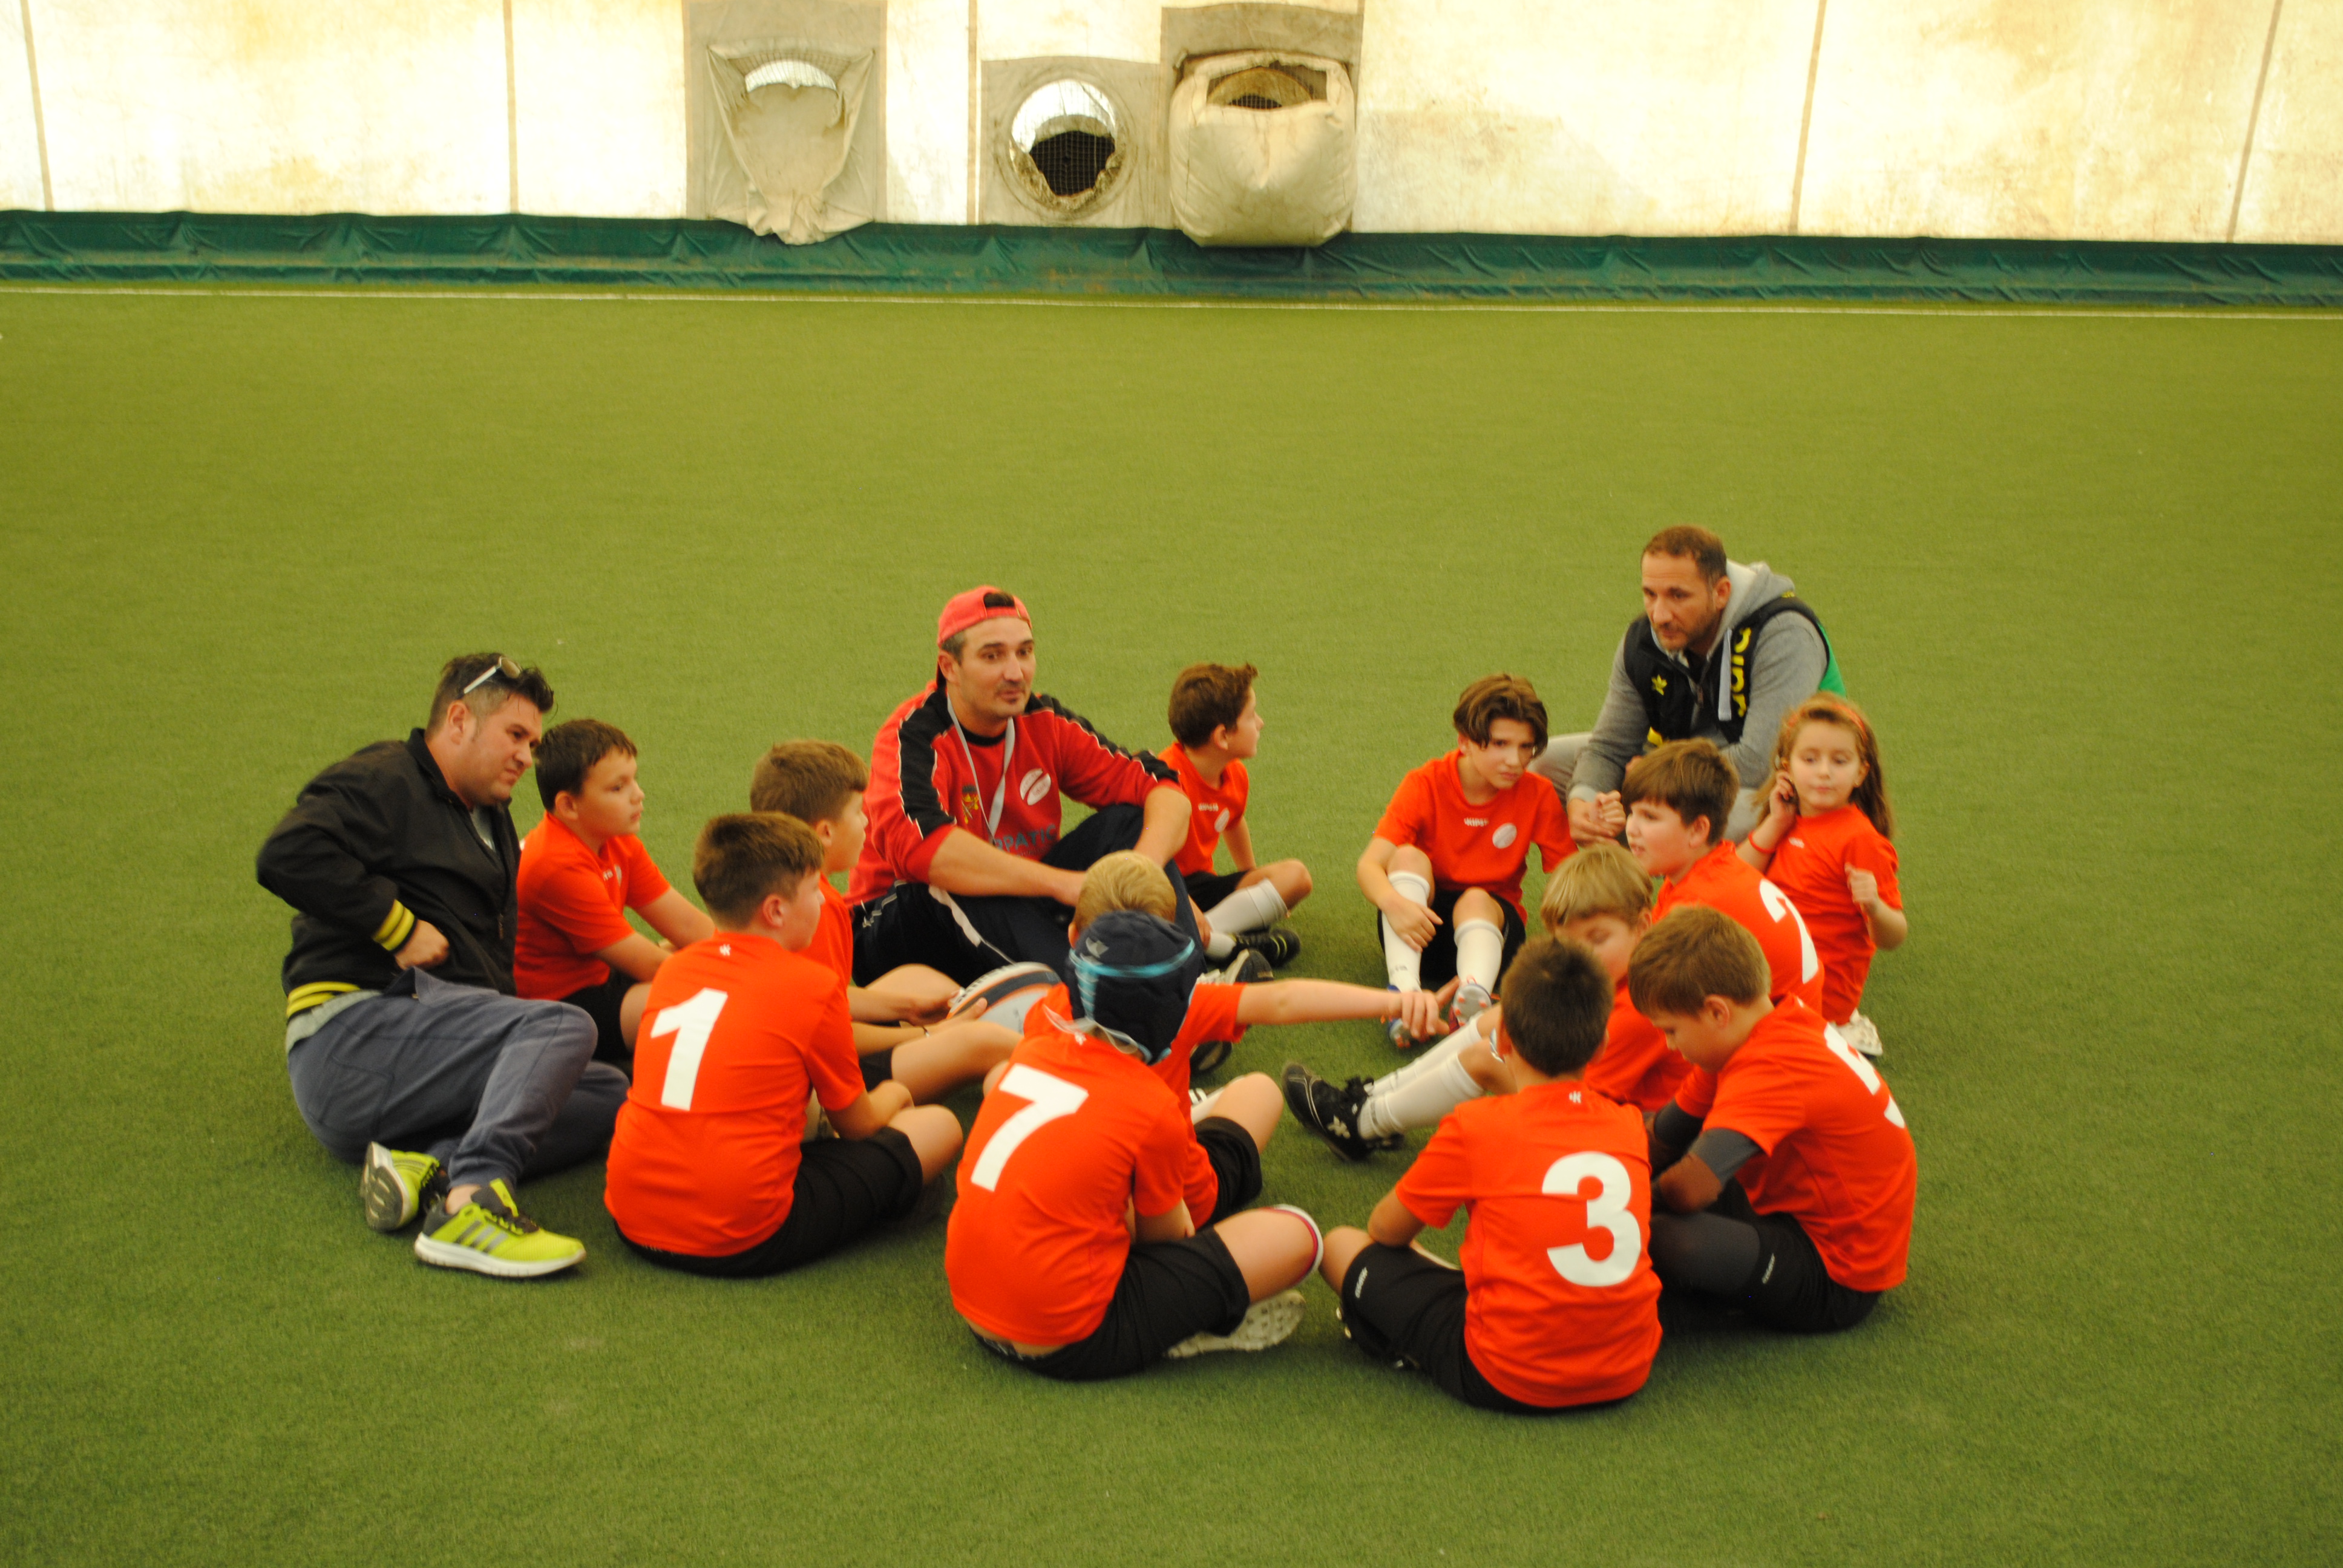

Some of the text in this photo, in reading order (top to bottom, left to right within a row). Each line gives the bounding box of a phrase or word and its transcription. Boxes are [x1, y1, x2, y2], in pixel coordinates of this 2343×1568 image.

[650, 987, 729, 1111] 1
[971, 1063, 1090, 1192] 7
[1542, 1151, 1641, 1287] 3
